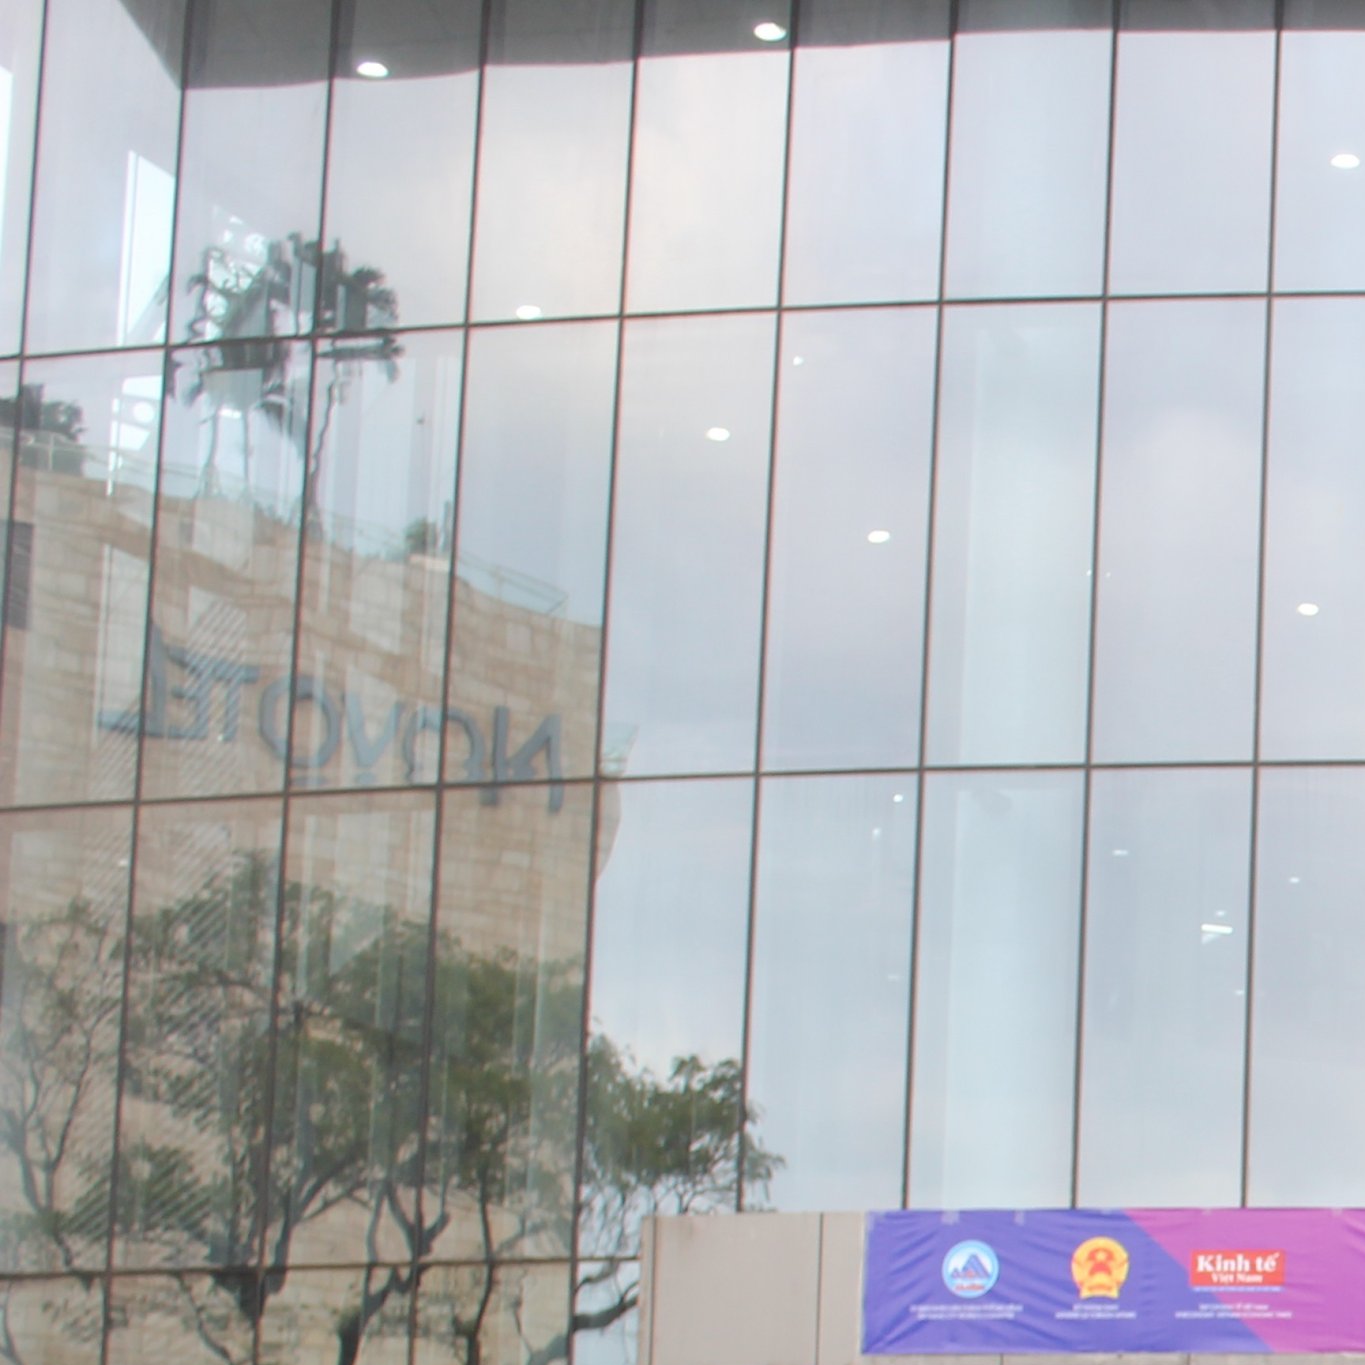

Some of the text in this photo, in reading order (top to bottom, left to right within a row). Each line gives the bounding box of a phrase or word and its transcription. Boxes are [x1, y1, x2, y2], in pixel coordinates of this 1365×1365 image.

[1196, 1252, 1280, 1273] Kinh tế
[1236, 1273, 1263, 1284] Nam
